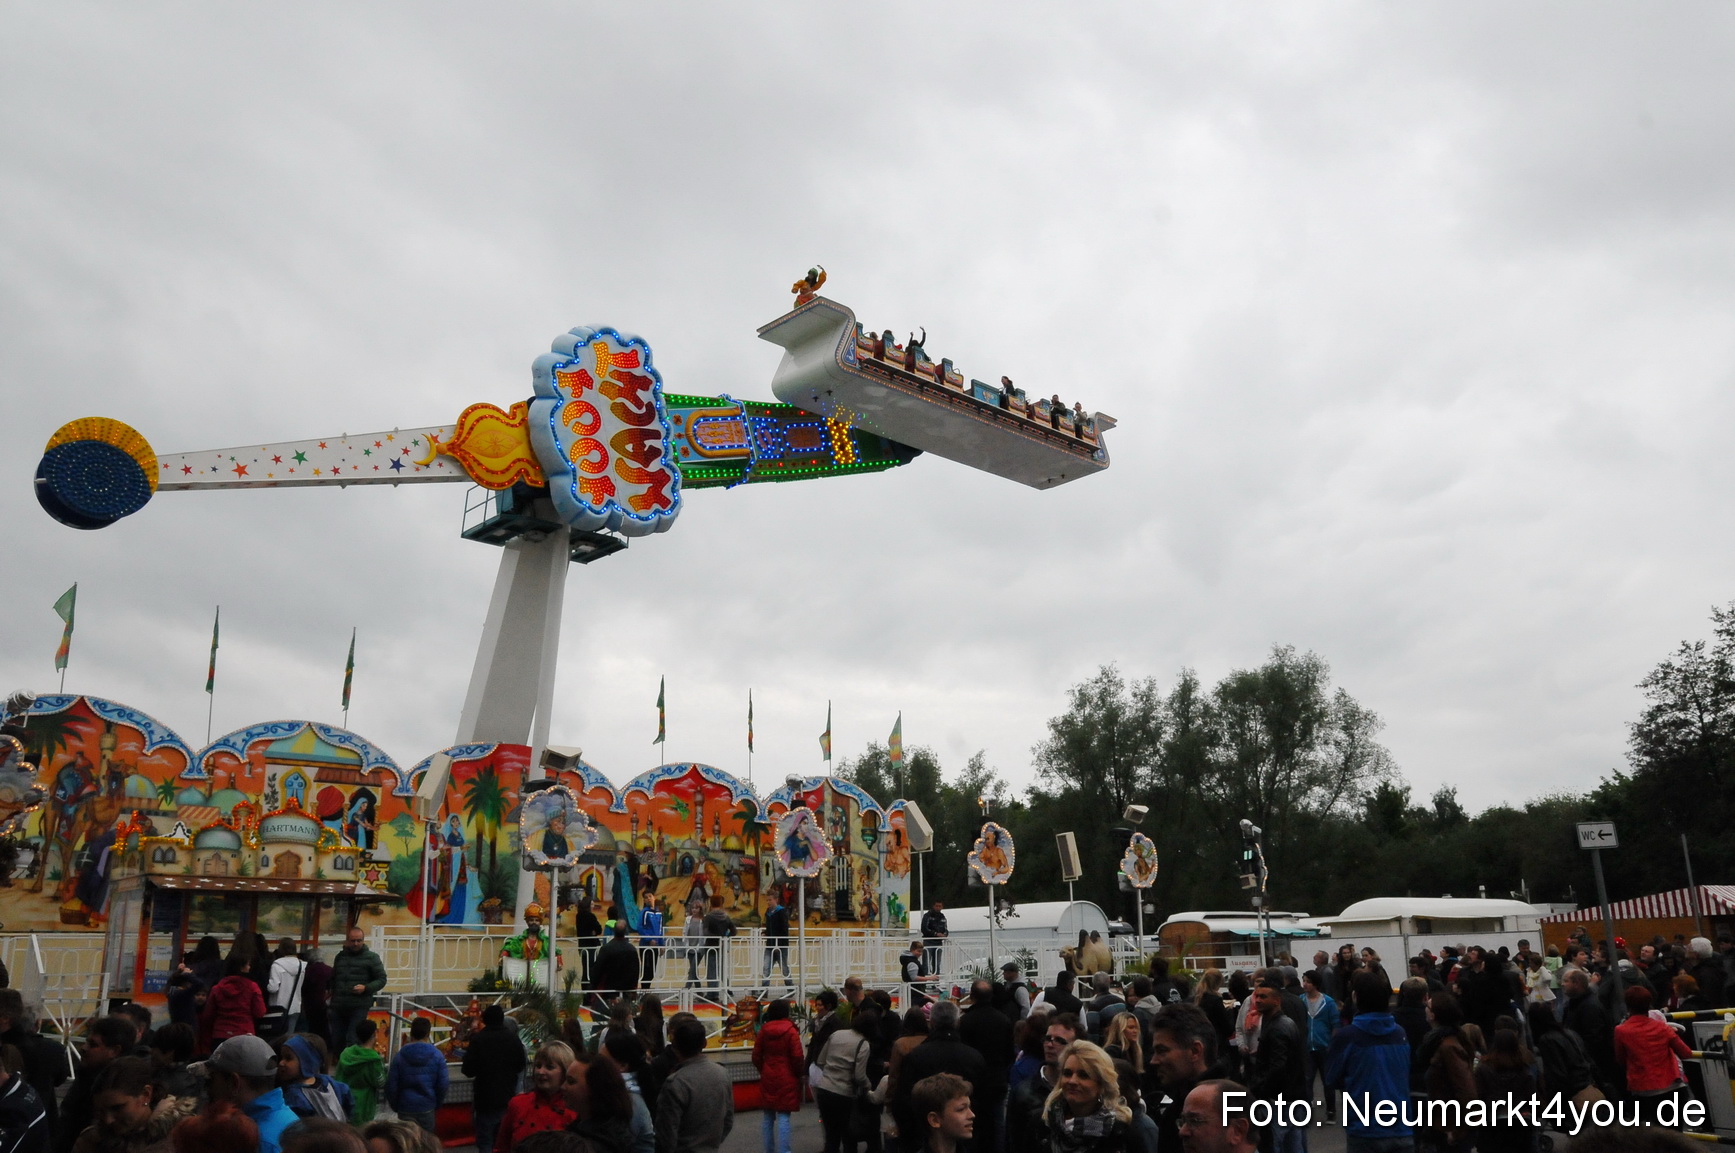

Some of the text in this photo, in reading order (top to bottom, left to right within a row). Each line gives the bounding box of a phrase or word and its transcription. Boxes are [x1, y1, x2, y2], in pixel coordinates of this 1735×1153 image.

[556, 368, 617, 506] 1001
[592, 340, 673, 513] NACHT
[262, 824, 317, 836] HARTMANN
[1581, 830, 1596, 841] WC
